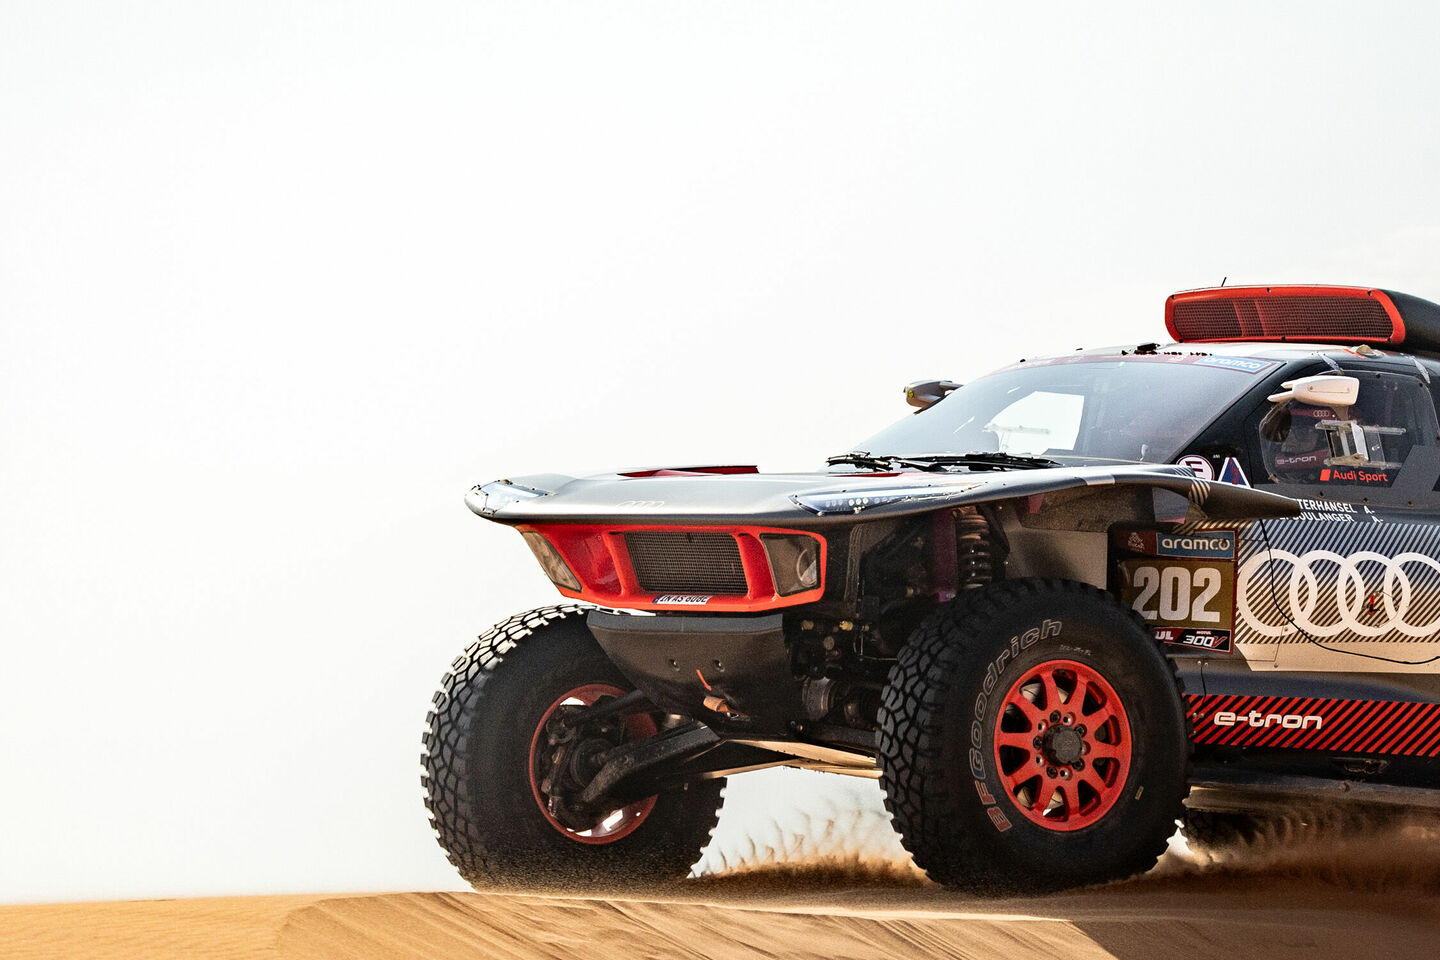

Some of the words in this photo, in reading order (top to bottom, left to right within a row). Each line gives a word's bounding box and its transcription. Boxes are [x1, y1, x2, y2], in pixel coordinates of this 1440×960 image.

[1276, 455, 1317, 465] e-tron
[1333, 470, 1357, 481] Audi
[1358, 470, 1389, 483] Sport
[1296, 499, 1358, 514] TERHANSEL
[1292, 511, 1355, 522] OULANGER
[1161, 538, 1230, 551] aramco
[1131, 566, 1222, 623] 202
[1183, 634, 1228, 648] 300V
[969, 619, 1063, 832] BFGoodrich
[1213, 710, 1323, 730] e-tron
